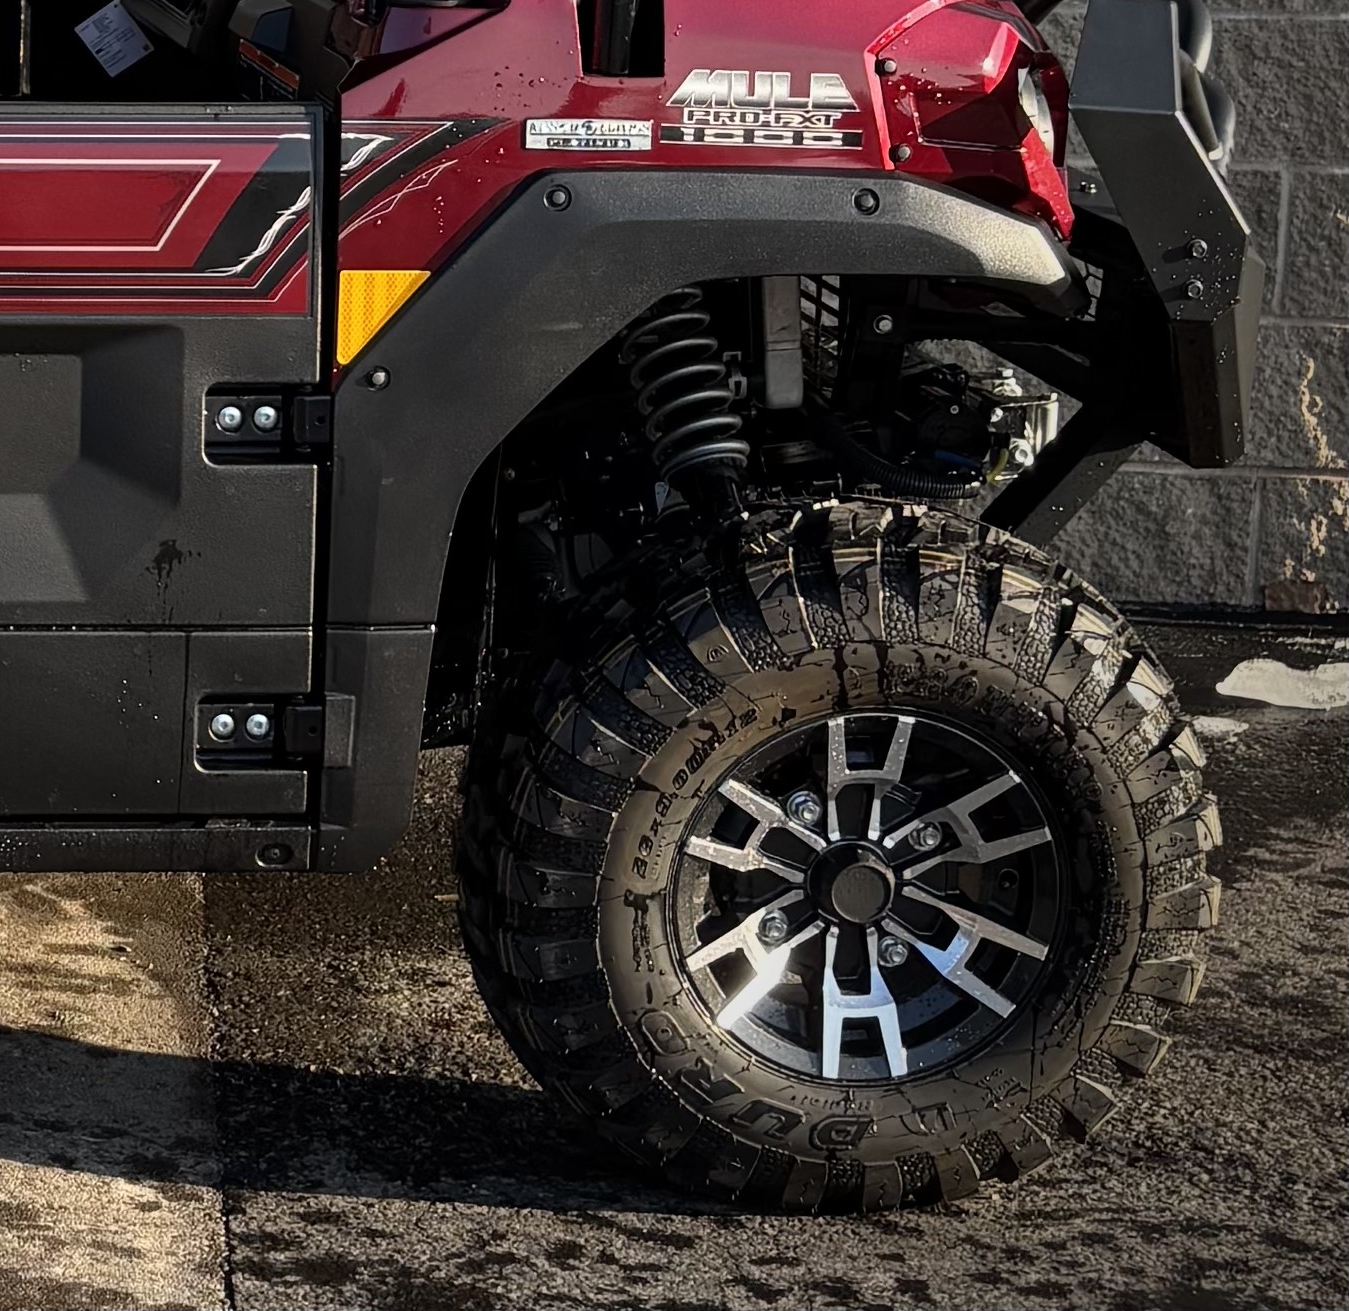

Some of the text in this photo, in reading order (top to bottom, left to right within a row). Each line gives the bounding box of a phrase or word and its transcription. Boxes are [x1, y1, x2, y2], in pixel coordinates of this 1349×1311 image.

[666, 69, 860, 112] MULE
[680, 127, 843, 145] 1000
[640, 1009, 875, 1152] DURO
